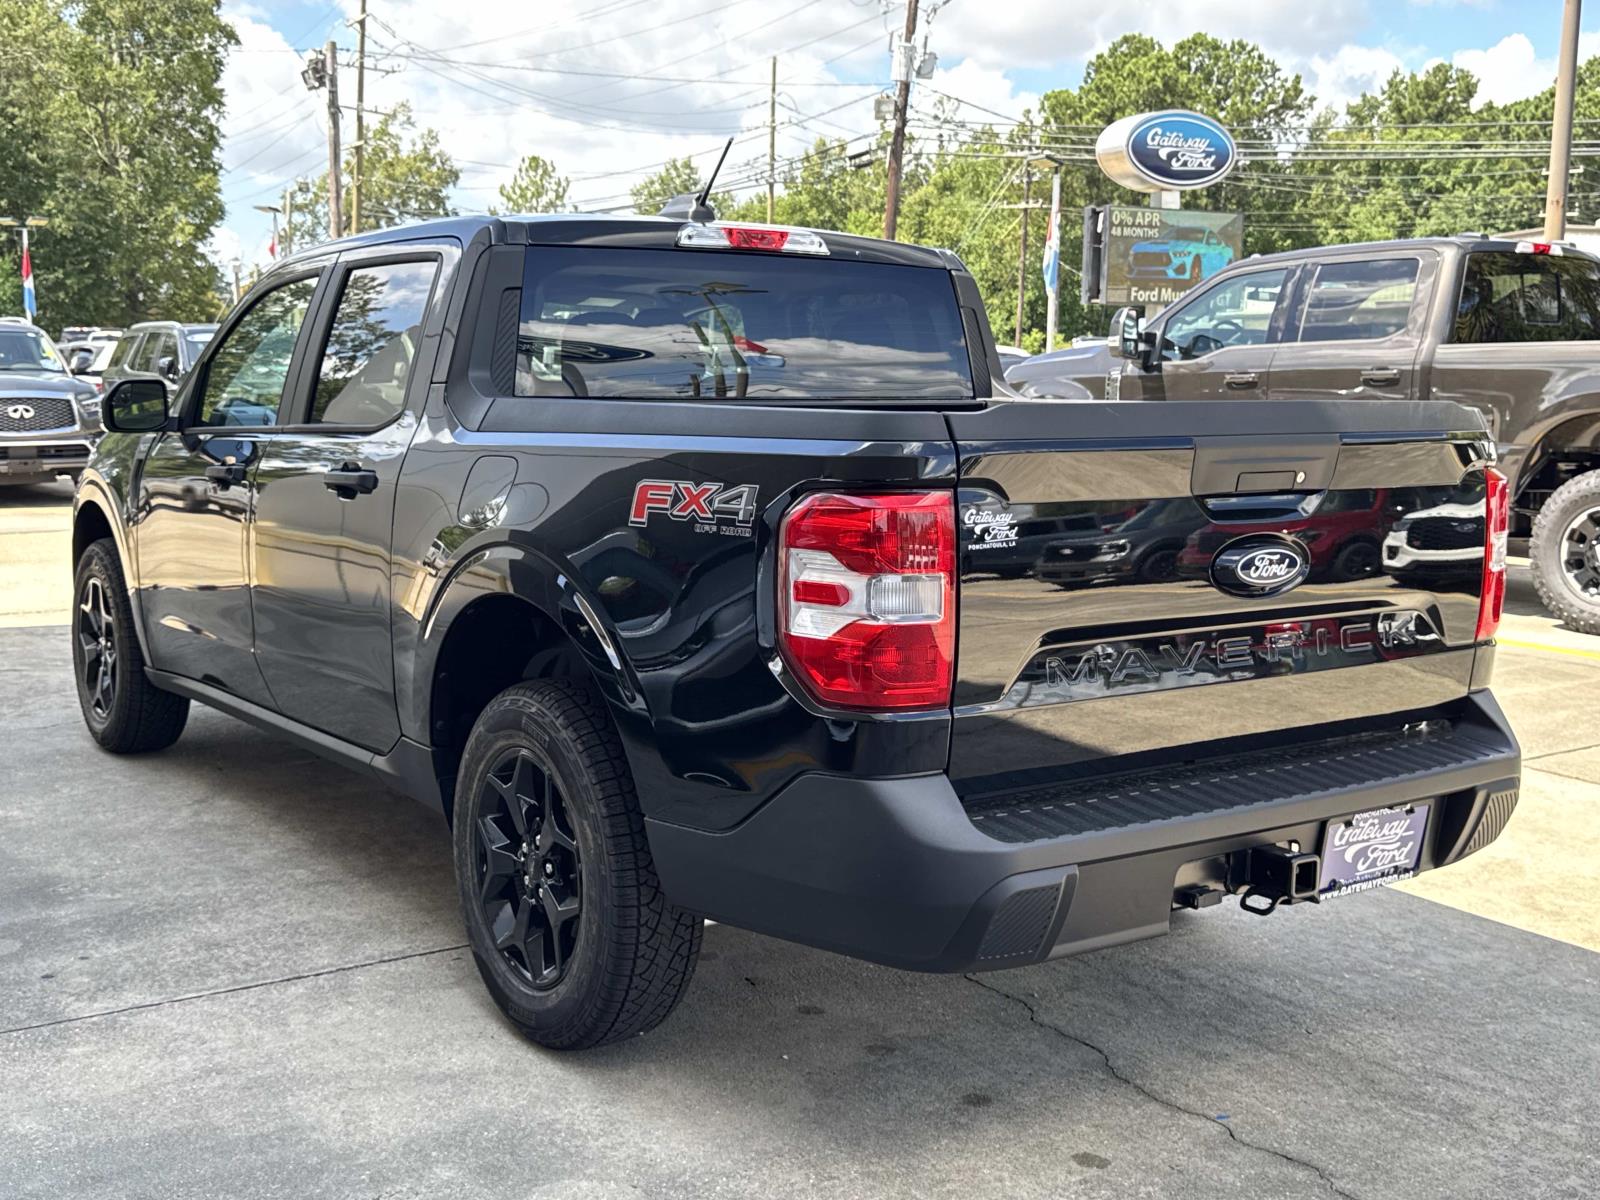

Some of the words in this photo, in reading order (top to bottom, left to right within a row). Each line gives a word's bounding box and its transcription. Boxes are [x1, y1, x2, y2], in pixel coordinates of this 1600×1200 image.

[1146, 127, 1210, 151] Gateway
[1159, 148, 1216, 169] Ford
[1112, 211, 1133, 226] 0%
[1135, 211, 1160, 226] APR
[1111, 226, 1122, 237] 48
[1123, 227, 1159, 238] MONTHS
[1130, 287, 1158, 302] Ford
[628, 479, 759, 527] FX4
[964, 508, 1016, 527] Gateway
[694, 523, 717, 533] OFF
[720, 525, 752, 537] ROAD
[974, 523, 1019, 542] Ford
[1250, 554, 1289, 578] Ford
[1045, 612, 1418, 690] MAVERICK
[1333, 818, 1413, 849] Gateway
[1344, 841, 1413, 871] Ford
